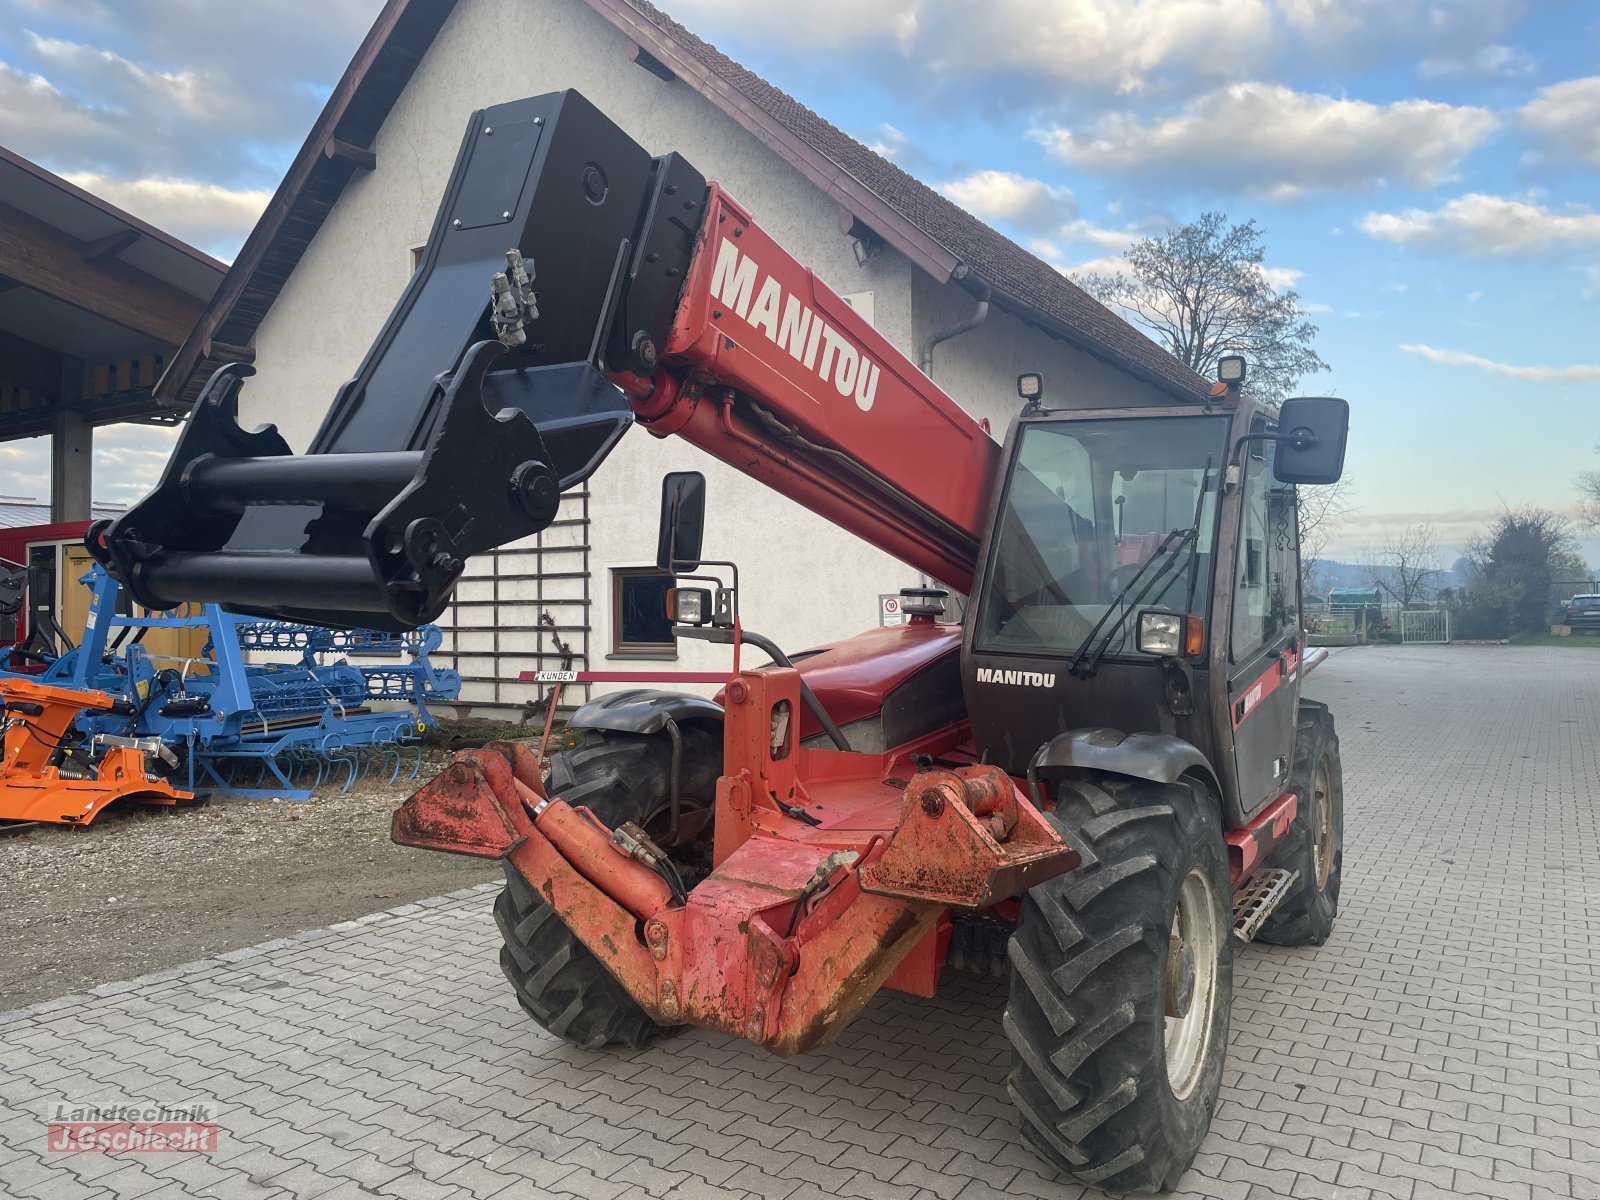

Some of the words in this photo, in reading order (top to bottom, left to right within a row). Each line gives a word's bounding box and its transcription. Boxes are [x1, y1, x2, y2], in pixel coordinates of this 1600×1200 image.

[710, 236, 881, 412] MANITOU
[540, 672, 575, 680] KUNDEN
[976, 667, 1056, 688] MANITOU
